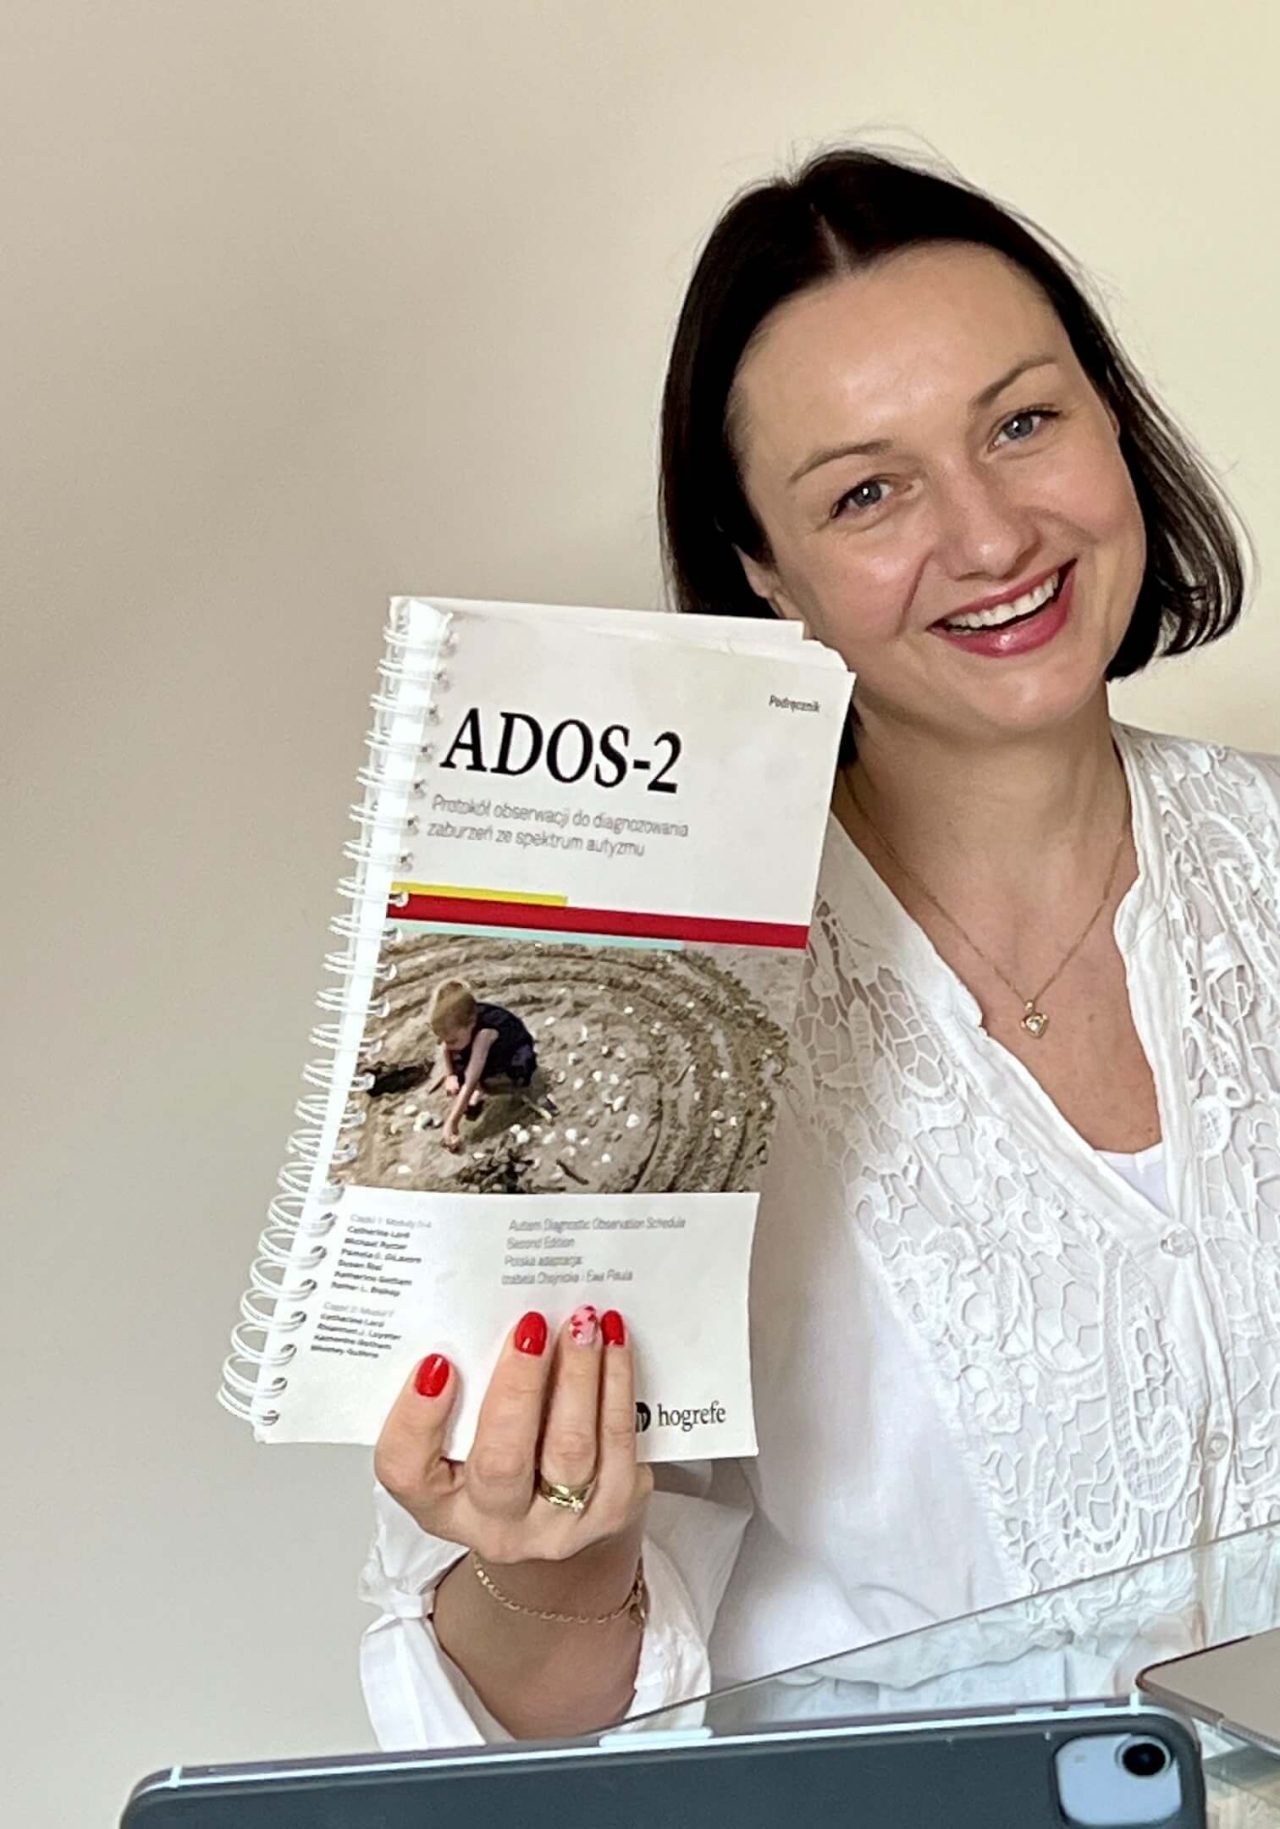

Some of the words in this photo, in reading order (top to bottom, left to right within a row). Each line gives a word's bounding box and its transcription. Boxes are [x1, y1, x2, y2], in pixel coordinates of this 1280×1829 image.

[439, 706, 683, 794] ADOS-2
[432, 794, 492, 816] Protokół
[493, 803, 570, 829] obserwacji
[572, 810, 590, 828] do
[593, 812, 689, 838] diagnozowania
[427, 821, 493, 842] zaburzeń
[495, 830, 512, 844] ze
[516, 832, 583, 851] spektrum
[586, 838, 646, 858] autyzmu
[657, 1400, 726, 1432] hogrefe
